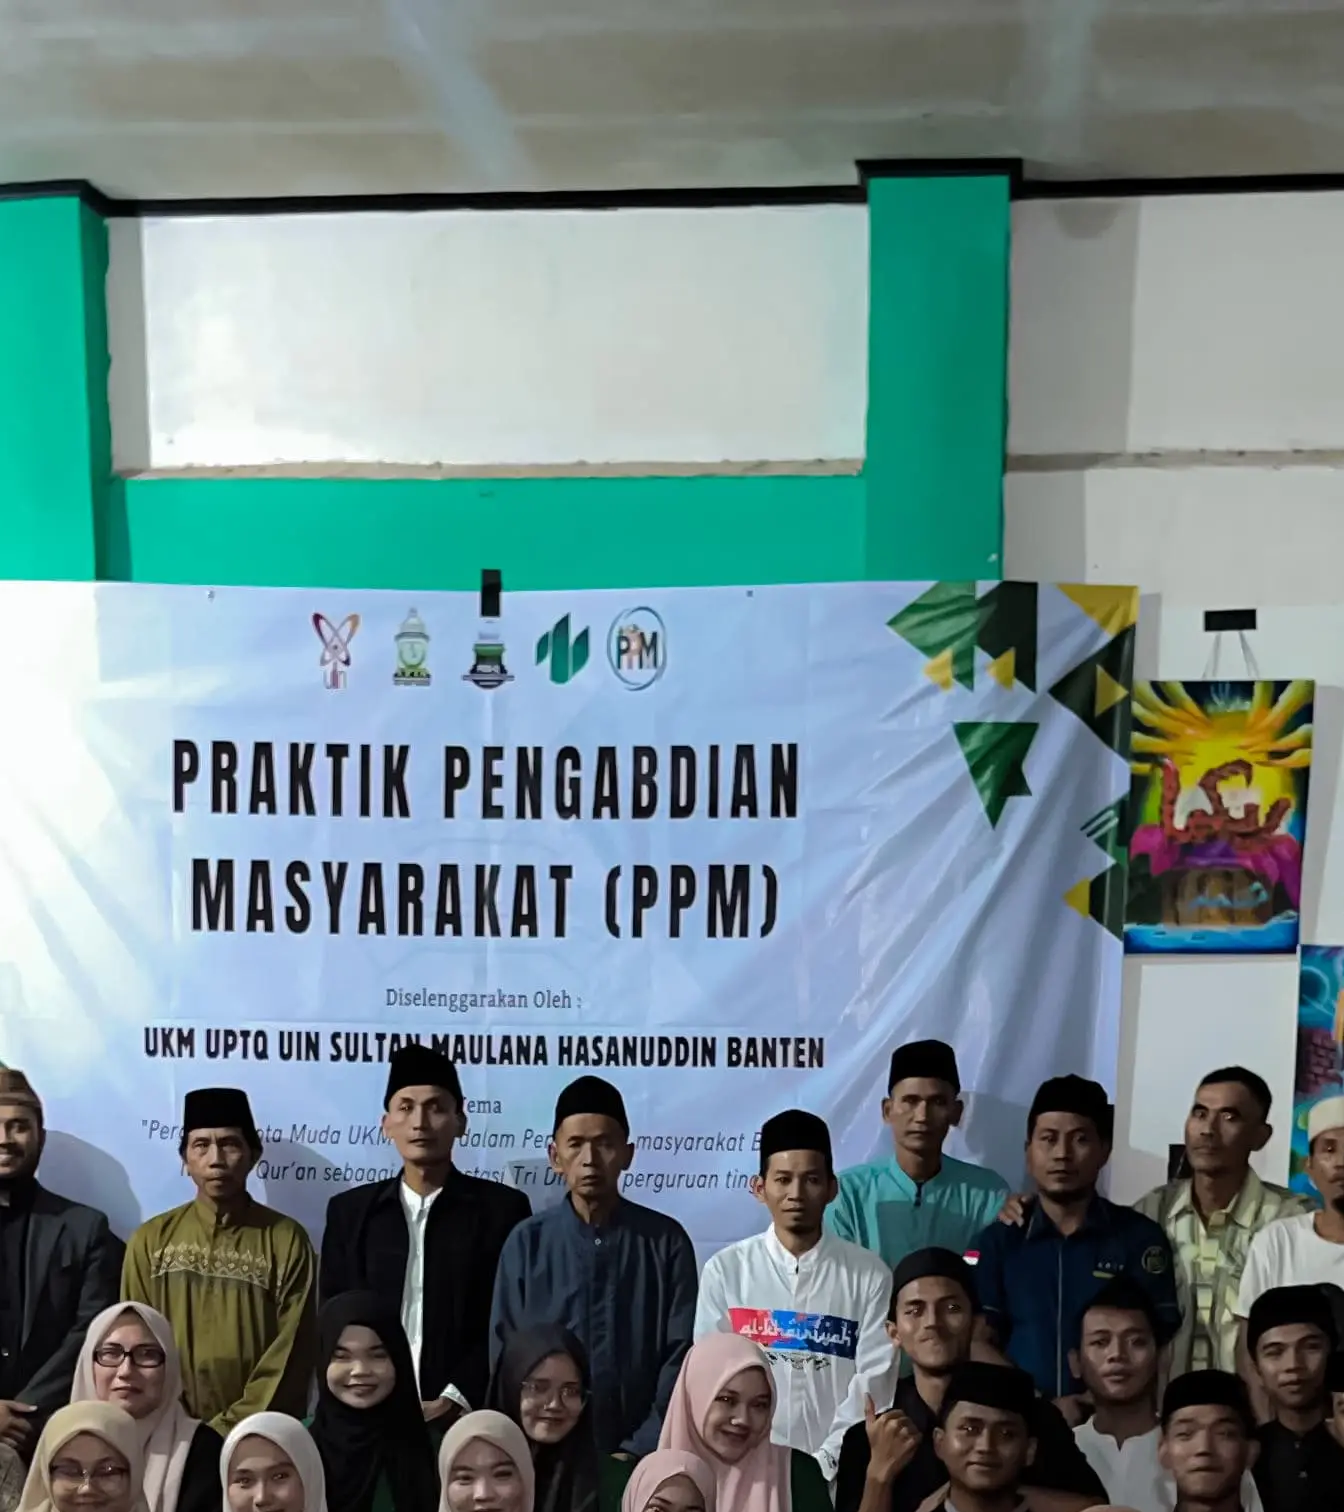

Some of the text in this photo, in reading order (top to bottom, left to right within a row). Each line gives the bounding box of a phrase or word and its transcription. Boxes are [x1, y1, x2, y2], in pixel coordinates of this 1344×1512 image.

[172, 739, 799, 820] PRAKTIK PENGABDIAN
[191, 858, 779, 939] MASYARAKAT (PPM)
[386, 988, 528, 1012] Diselenggarakan
[534, 989, 572, 1009] Oleh
[144, 1026, 196, 1058] UKM
[205, 1028, 269, 1061] UPTQ
[279, 1030, 320, 1062] UIN
[558, 1035, 717, 1068] HASANUDDIN
[727, 1036, 824, 1069] BANTEN
[464, 1098, 502, 1114] ema
[289, 1123, 342, 1144] Muda
[459, 1128, 515, 1149] dalam
[636, 1130, 745, 1156] masyarakat
[513, 1165, 538, 1186] Tri
[622, 1172, 719, 1194] perguruan
